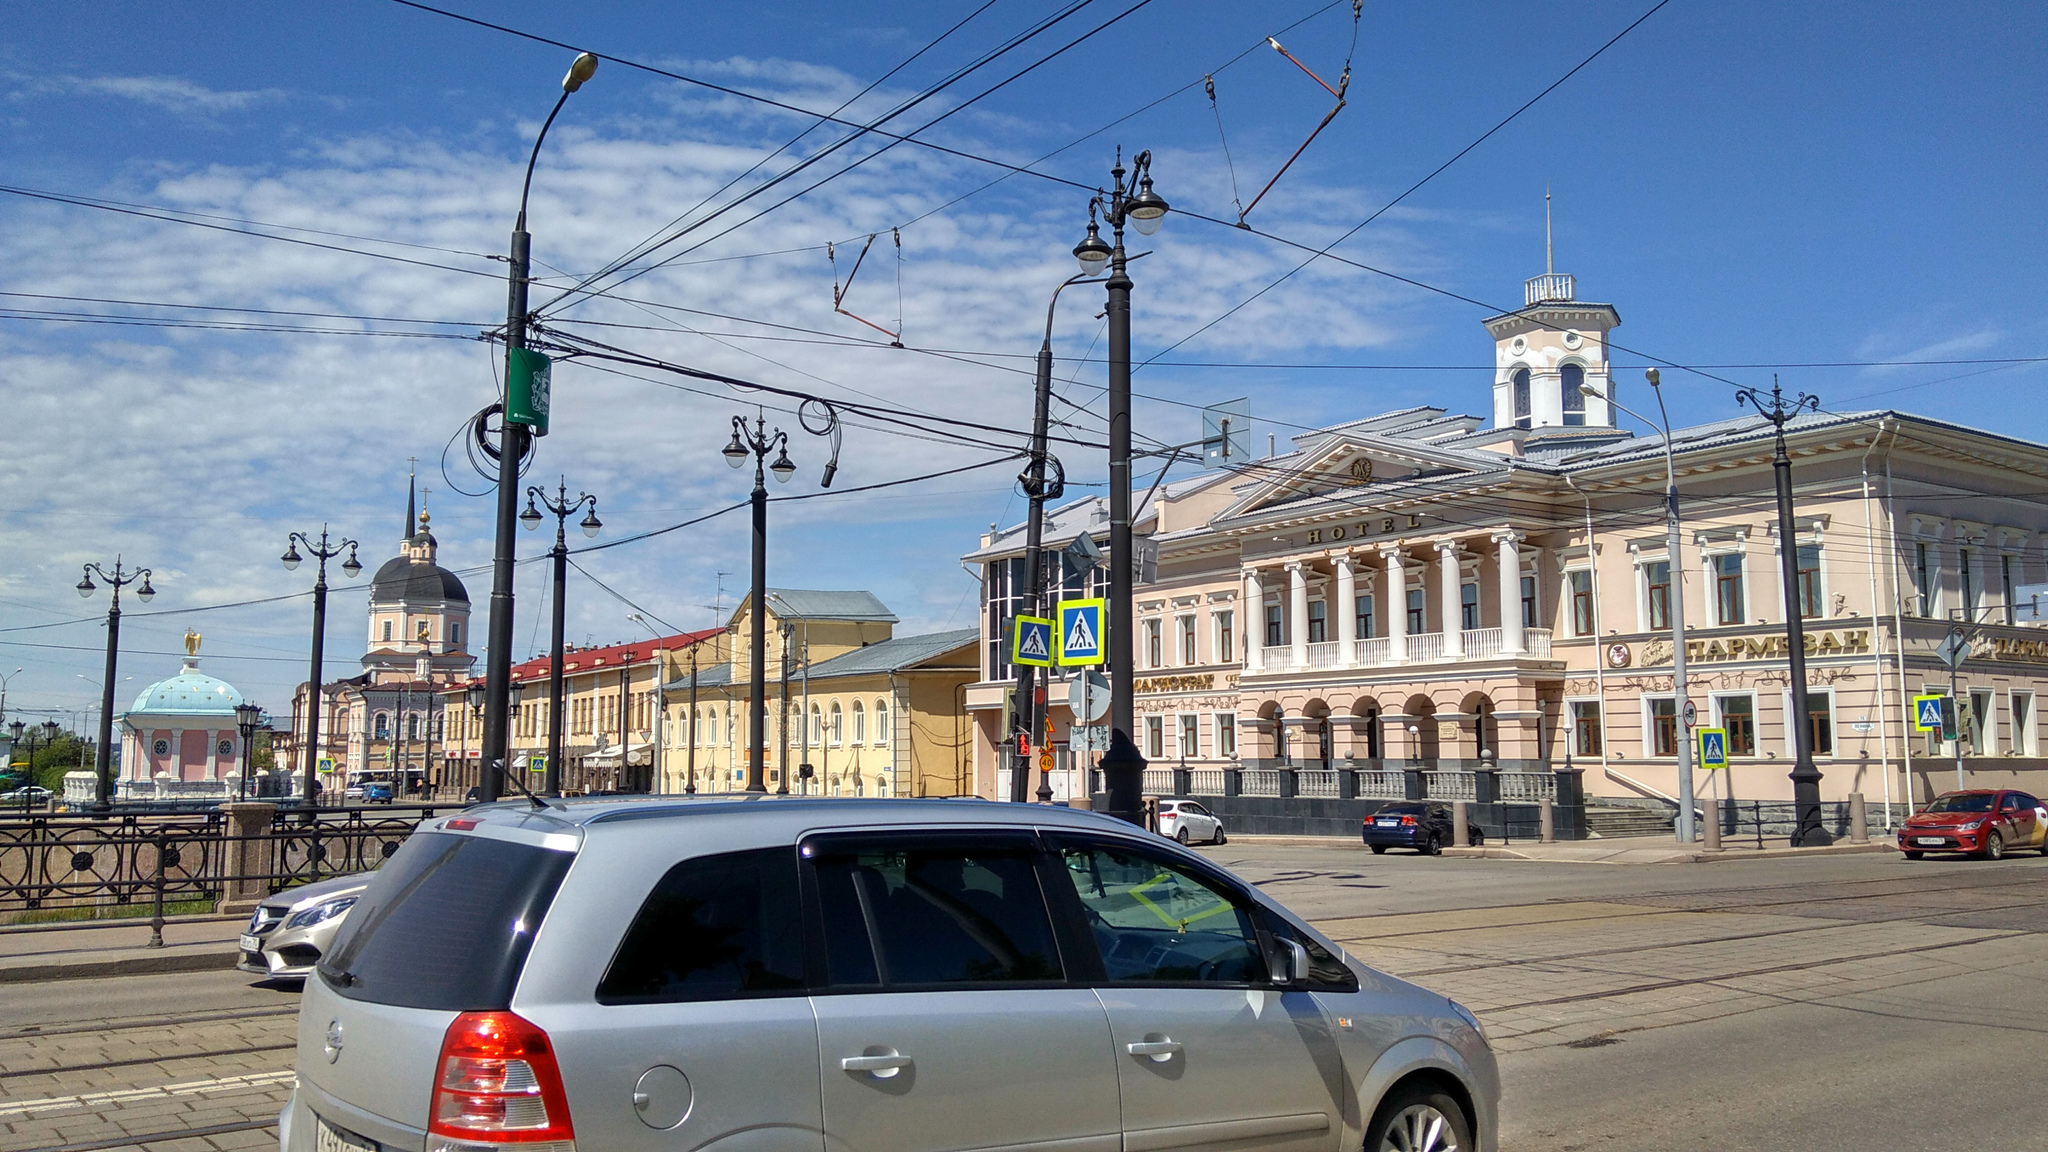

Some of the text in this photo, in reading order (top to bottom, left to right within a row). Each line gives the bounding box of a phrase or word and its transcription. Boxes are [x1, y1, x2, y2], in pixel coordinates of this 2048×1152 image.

[1307, 515, 1421, 544] HOTEL
[1685, 630, 1870, 658] ПАРМЕЗАН
[1995, 637, 2048, 657] ПАРМ
[1042, 759, 1052, 767] 40
